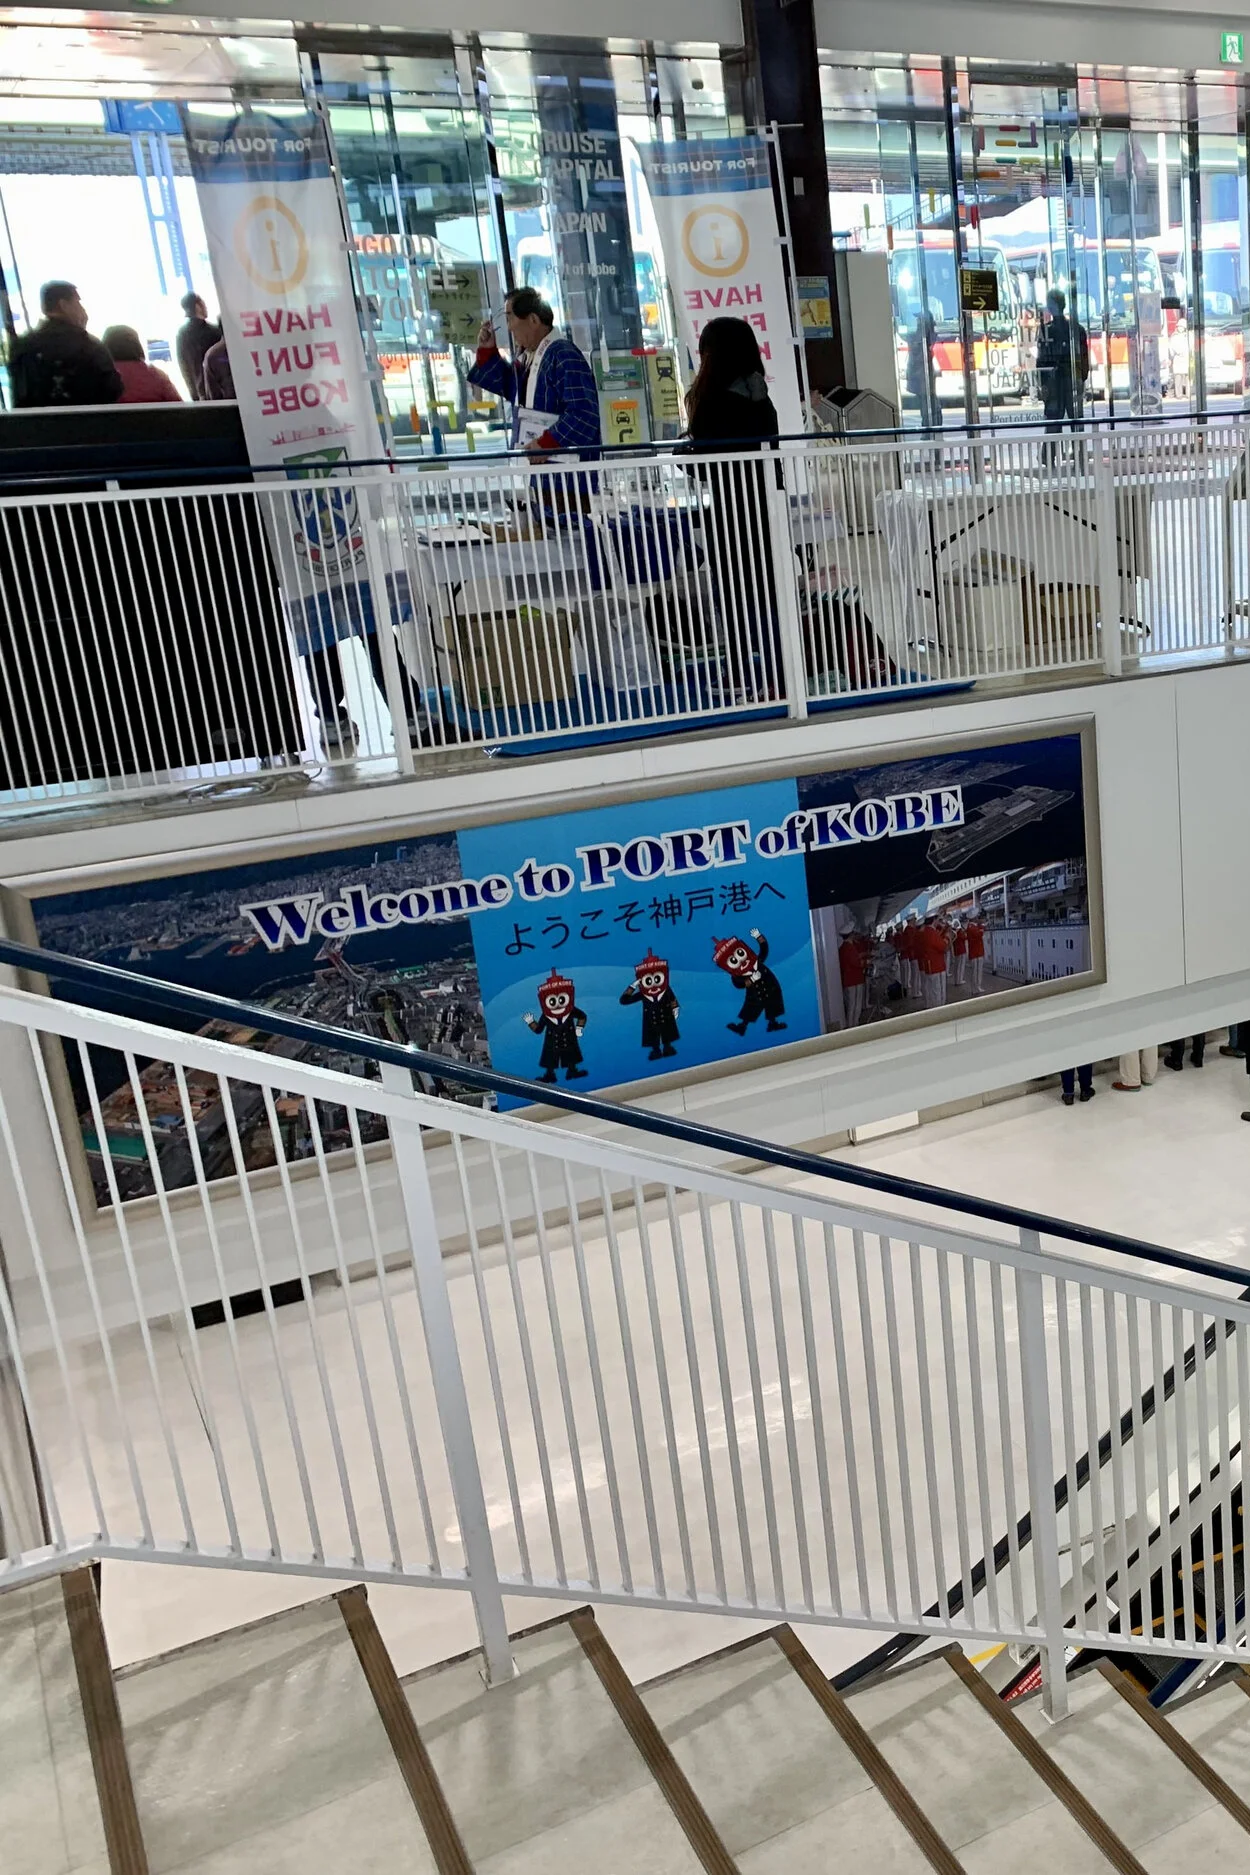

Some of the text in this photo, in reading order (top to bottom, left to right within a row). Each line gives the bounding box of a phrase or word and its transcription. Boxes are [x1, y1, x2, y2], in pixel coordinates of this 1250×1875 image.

[531, 130, 607, 154] CRUISE
[541, 211, 607, 233] JAPAN
[361, 234, 435, 260] GOOD
[366, 265, 400, 291] TO
[990, 348, 1009, 367] OF
[992, 371, 1042, 390] JAPAN
[995, 413, 1013, 424] Port
[1014, 412, 1024, 423] of
[239, 784, 964, 951] Welcome to PORT of KOBE
[505, 880, 786, 957] ようこそ神戸港へ
